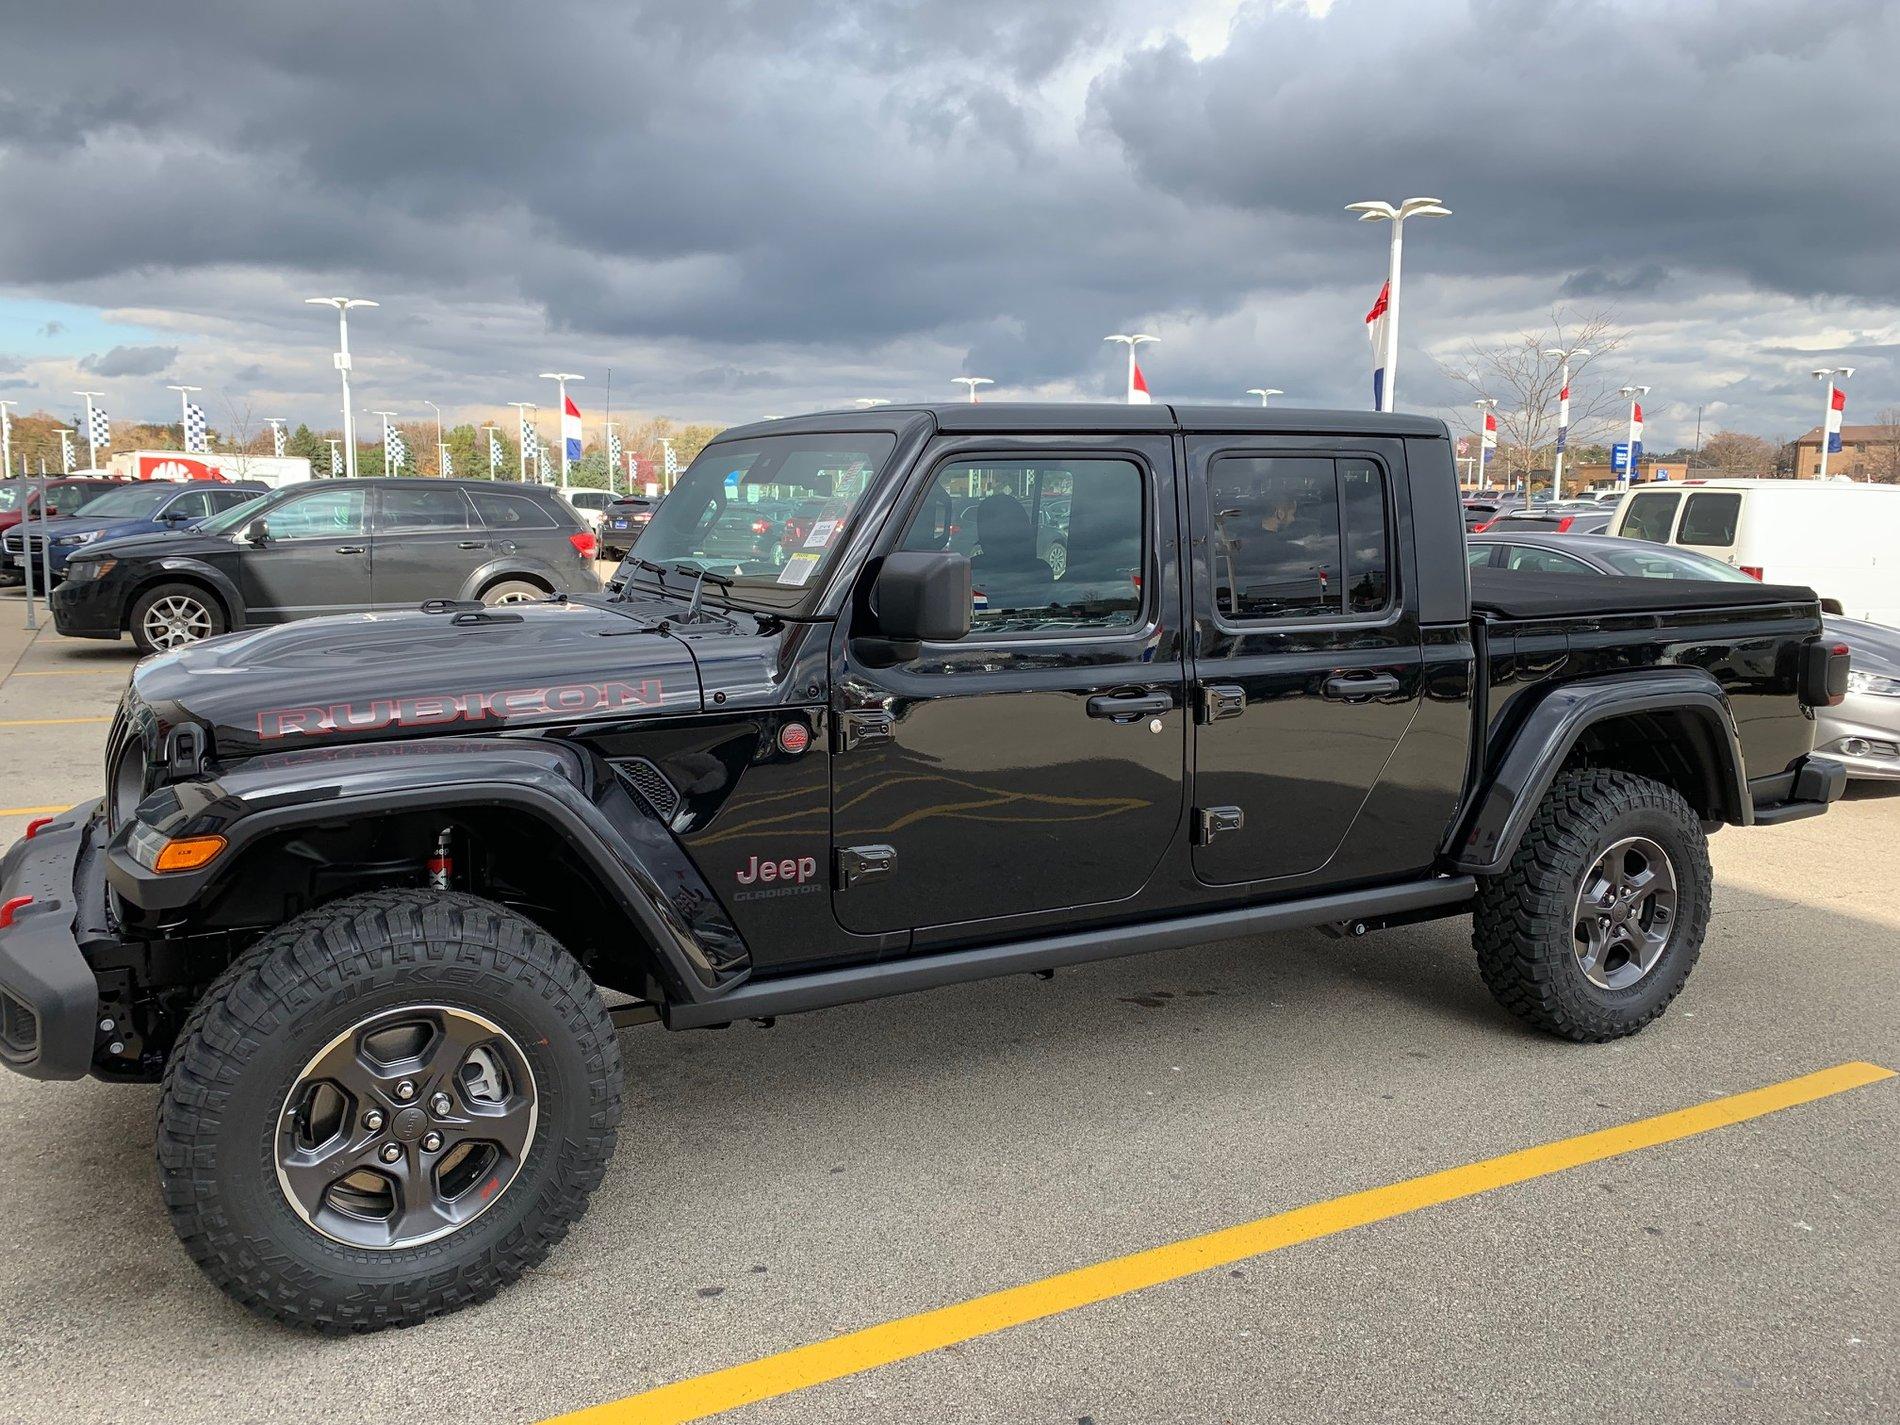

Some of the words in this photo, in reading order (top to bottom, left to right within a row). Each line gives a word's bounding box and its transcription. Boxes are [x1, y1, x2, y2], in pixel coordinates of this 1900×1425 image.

[257, 679, 663, 740] RUBICON
[736, 855, 818, 885] Jeep
[733, 884, 822, 902] GLADIATOR
[289, 964, 515, 1039] FALKEN
